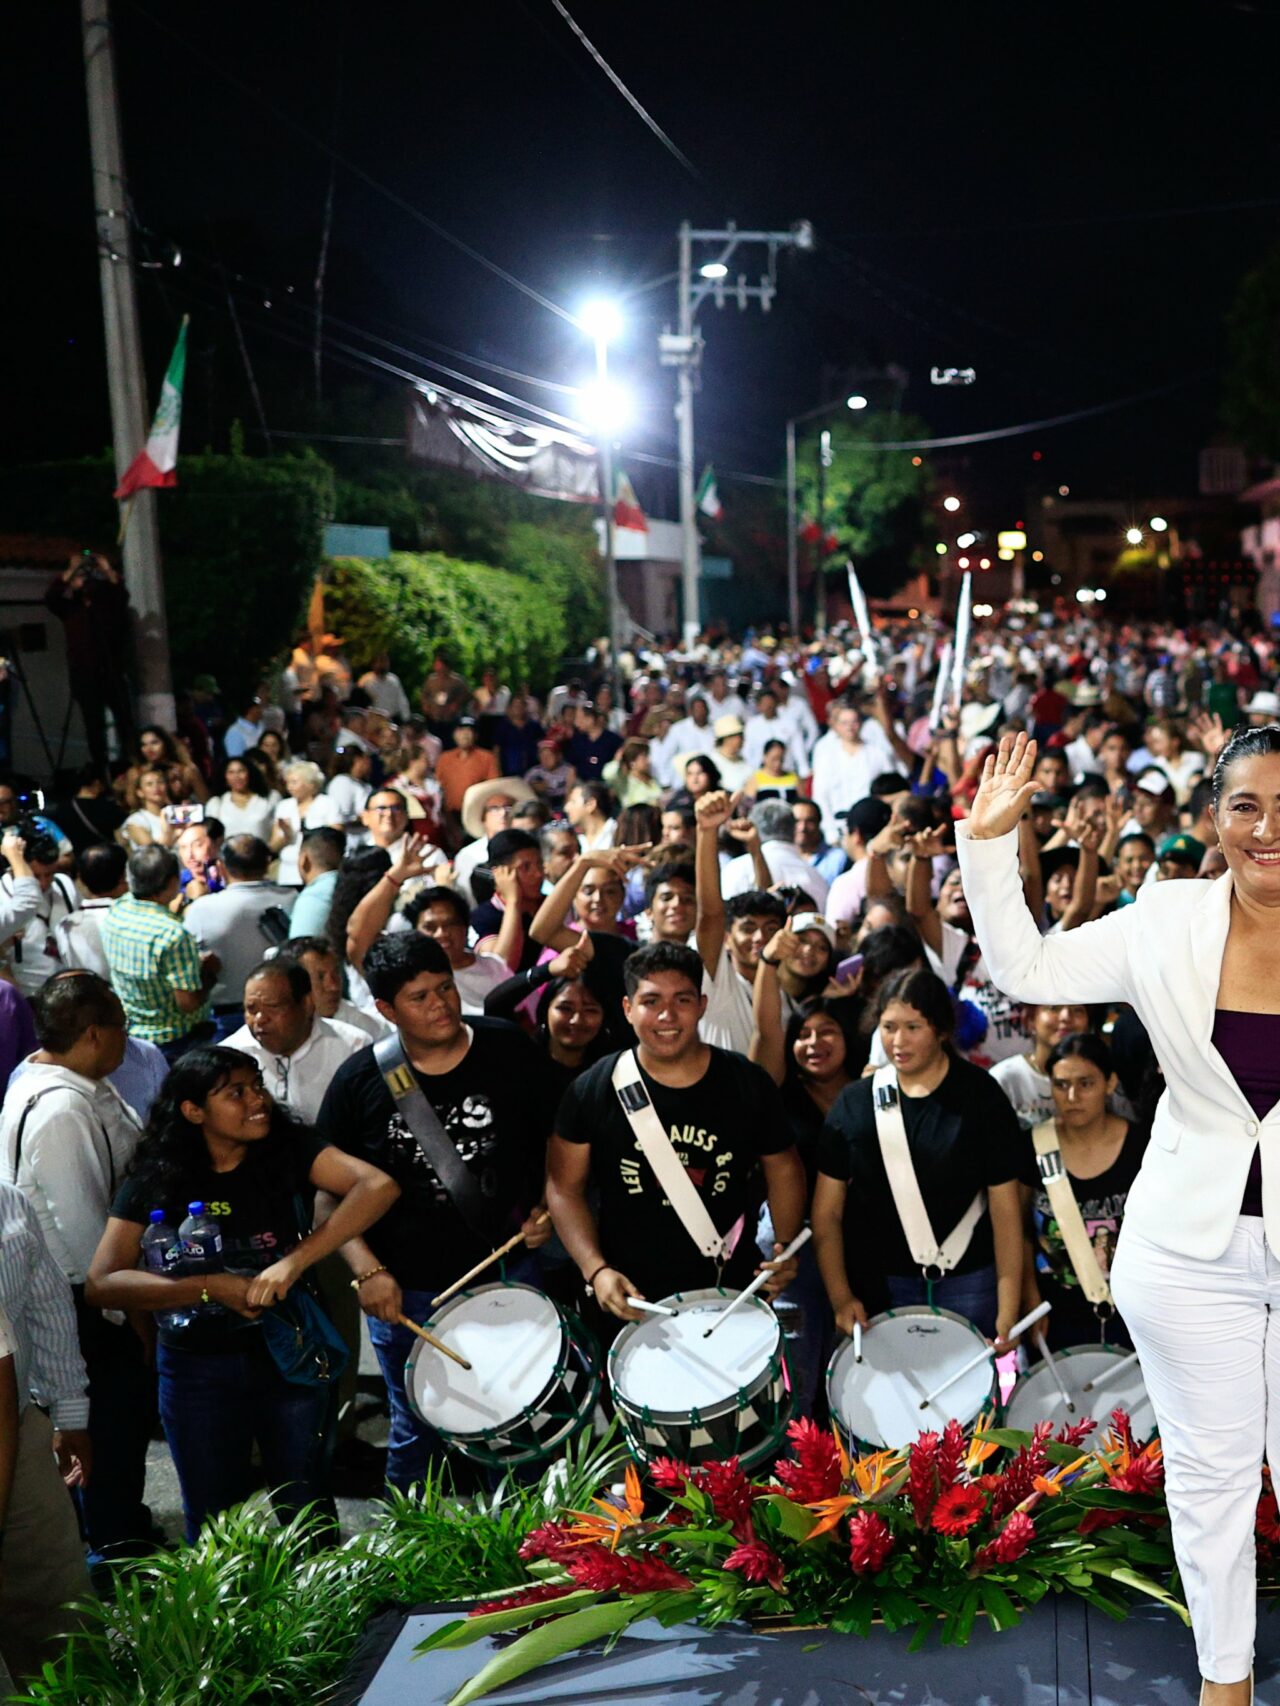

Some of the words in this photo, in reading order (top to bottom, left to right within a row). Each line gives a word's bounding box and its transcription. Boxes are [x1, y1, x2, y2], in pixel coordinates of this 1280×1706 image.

[620, 1158, 643, 1194] LEVI
[634, 1124, 718, 1152] AUSS
[715, 1152, 733, 1167] &
